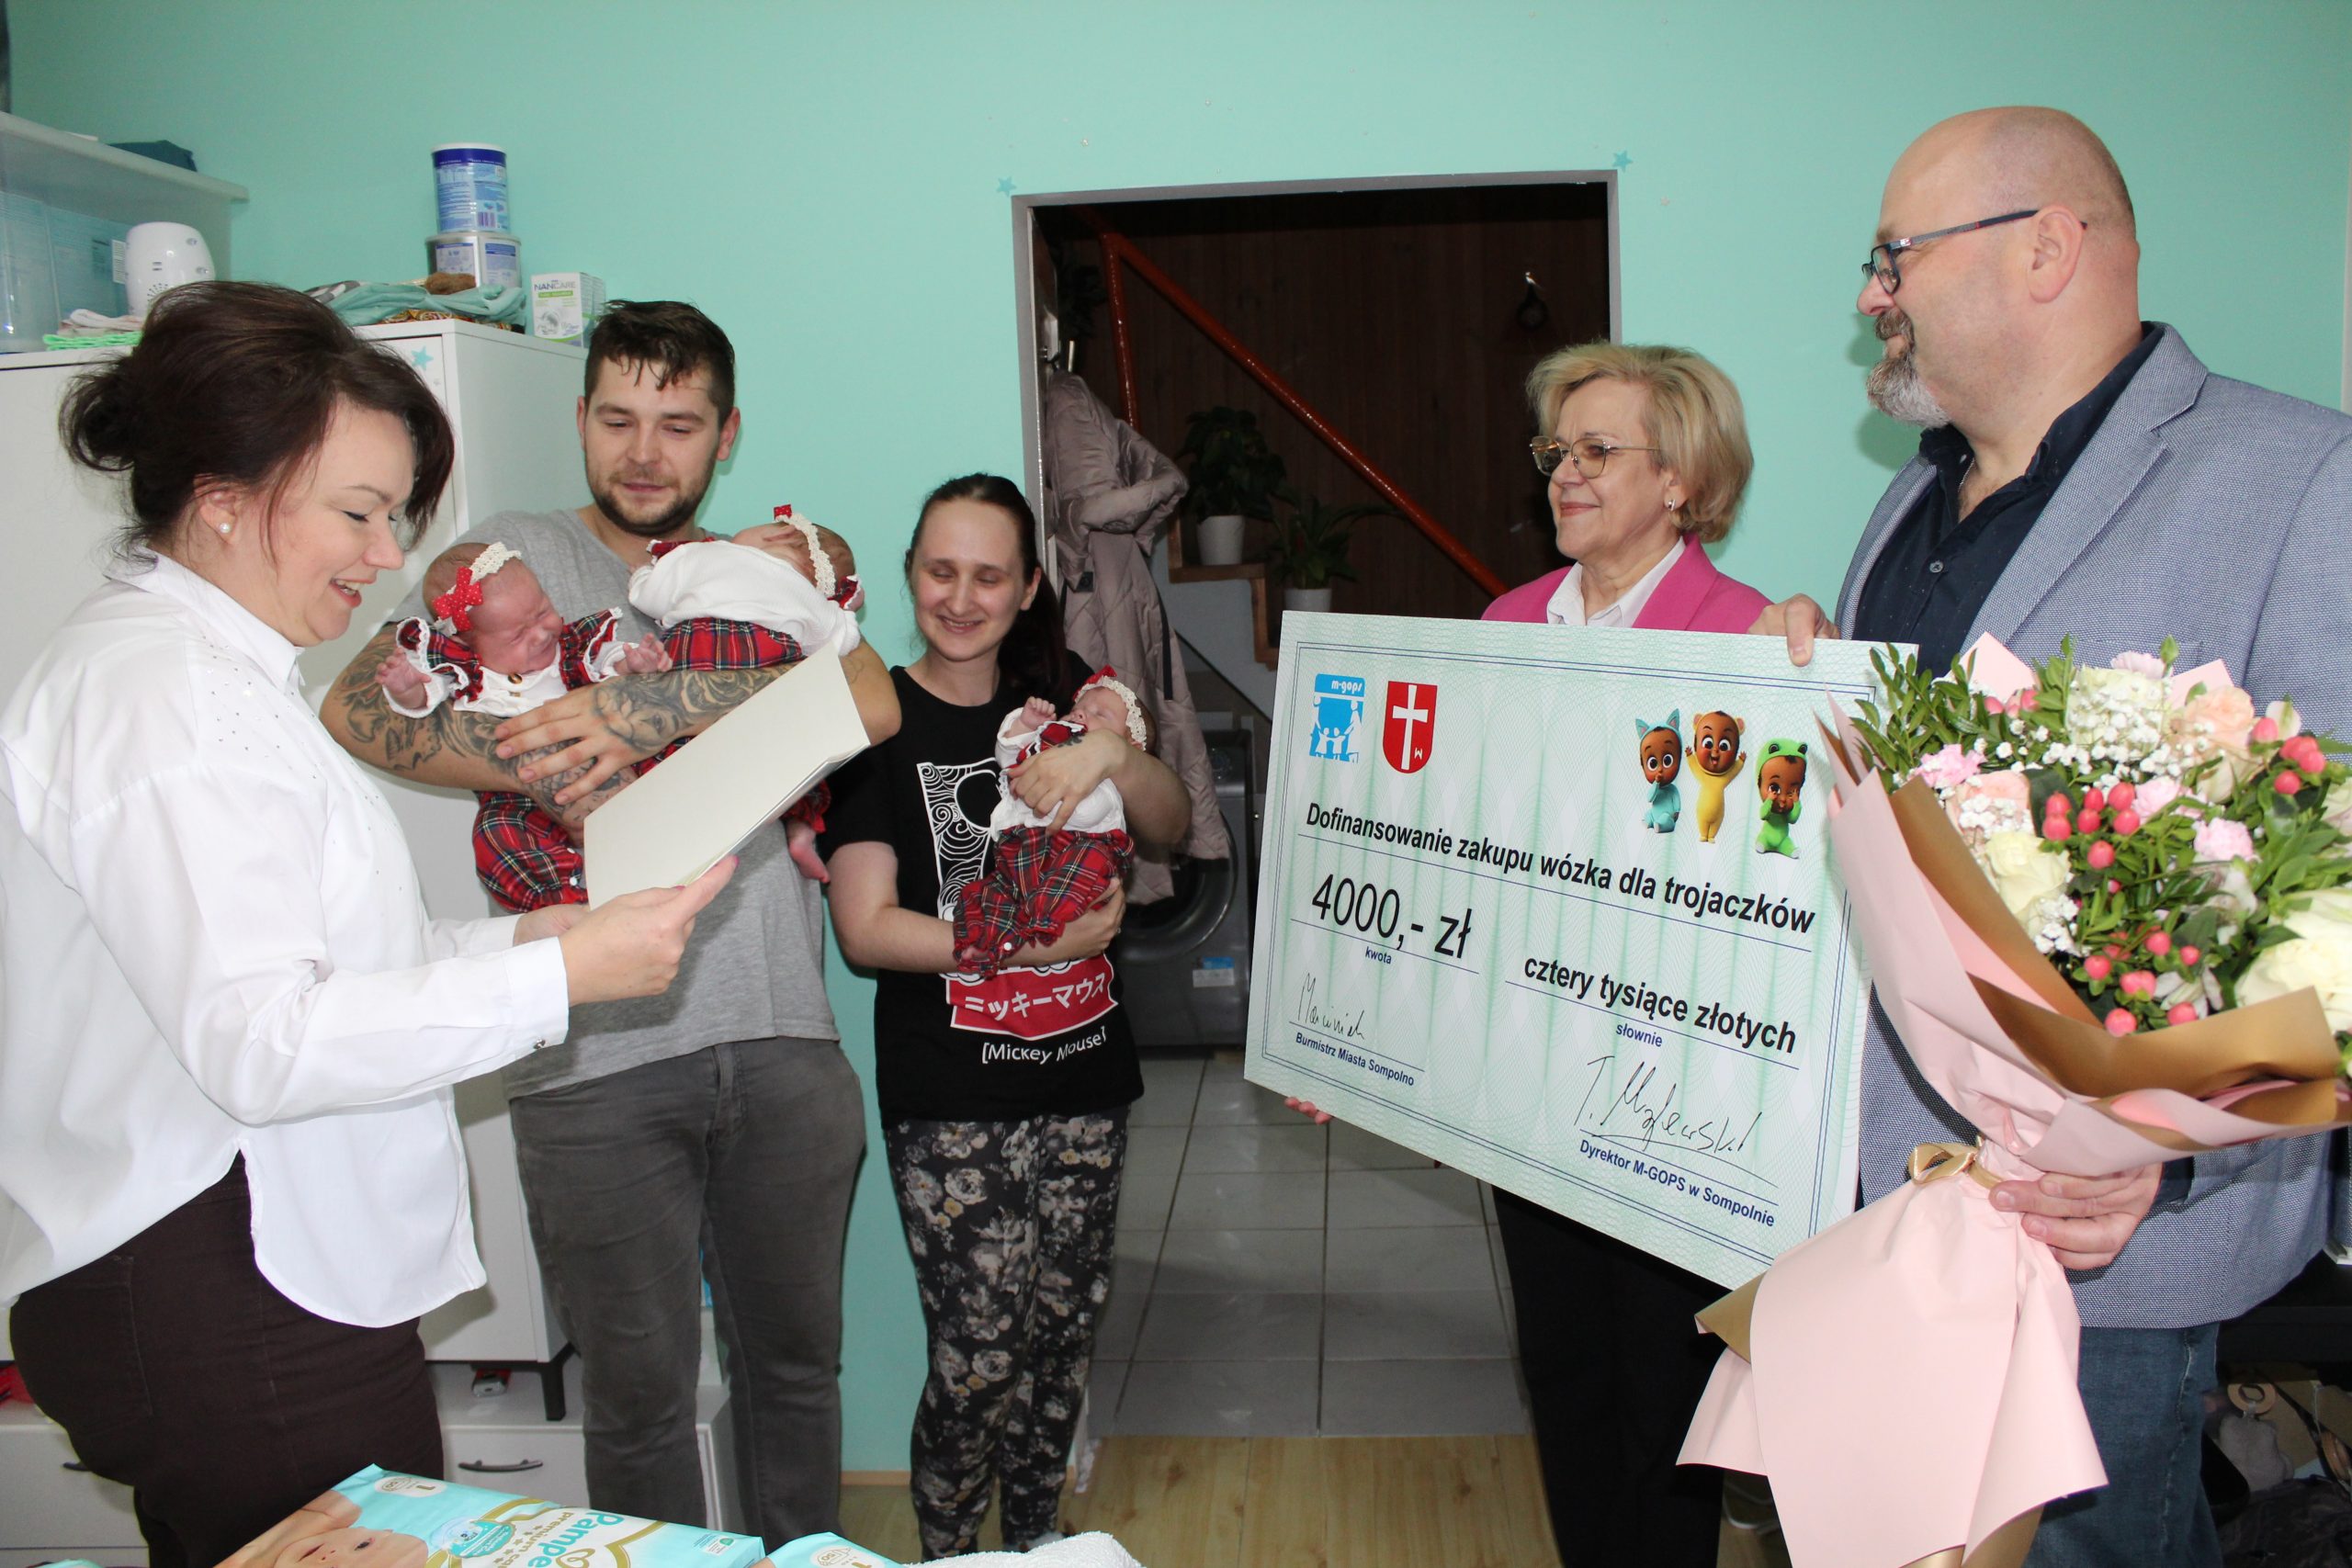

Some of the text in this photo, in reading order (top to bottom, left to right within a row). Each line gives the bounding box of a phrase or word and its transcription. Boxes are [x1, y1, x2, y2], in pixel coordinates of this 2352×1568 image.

[1331, 680, 1363, 694] m-gops
[1306, 802, 1815, 934] Dofinansowanie zakupu wózka dla trojaczków
[1364, 946, 1392, 964] kwota
[1434, 908, 1473, 959] zł
[965, 973, 1106, 1021] ミッキーマウス
[1524, 957, 1796, 1054] cztery tysiące złotych
[1295, 1032, 1415, 1087] Burmistrz Miasta Sompolno
[1615, 1023, 1663, 1047] słownie
[1579, 1139, 1775, 1228] Dyrektor M-GOPS w Sompolnie
[519, 1511, 574, 1553] premium
